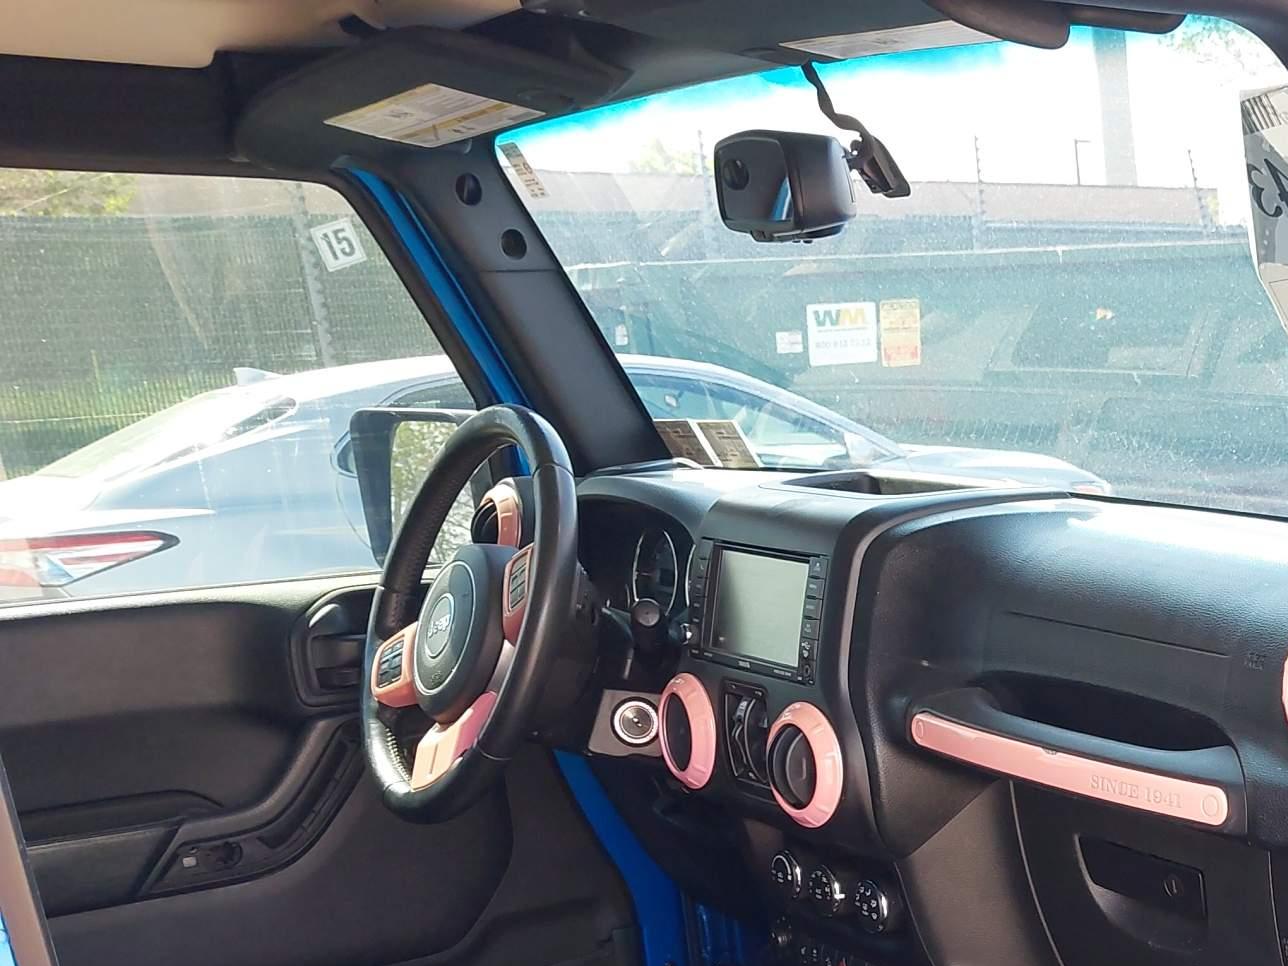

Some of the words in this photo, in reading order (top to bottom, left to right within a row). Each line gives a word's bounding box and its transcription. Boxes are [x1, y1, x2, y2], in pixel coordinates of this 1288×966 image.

[320, 228, 356, 261] 15
[814, 307, 866, 328] WM
[427, 614, 451, 639] Jeep
[1090, 774, 1139, 799] SINCE
